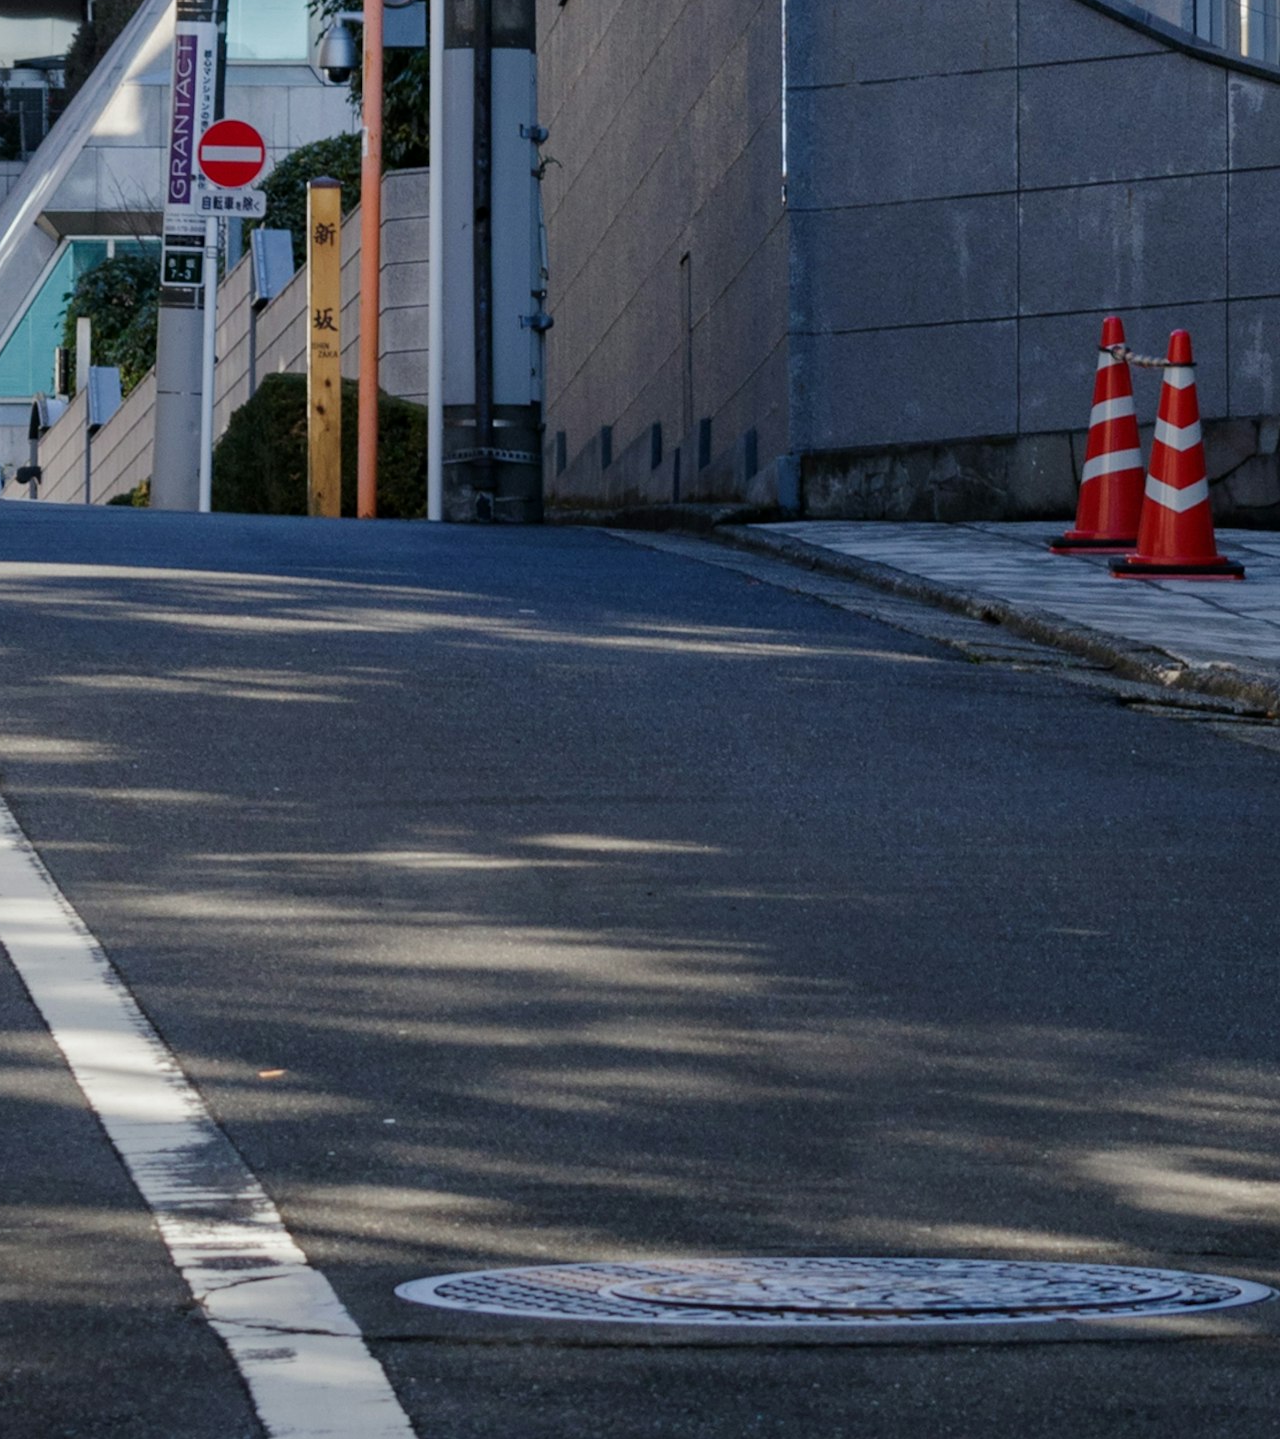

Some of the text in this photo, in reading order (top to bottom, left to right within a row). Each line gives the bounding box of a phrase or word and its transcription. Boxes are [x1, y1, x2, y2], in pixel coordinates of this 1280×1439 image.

[170, 40, 193, 200] GRANTACT
[201, 195, 261, 212] 自転車を除く
[313, 222, 338, 332] 新坂
